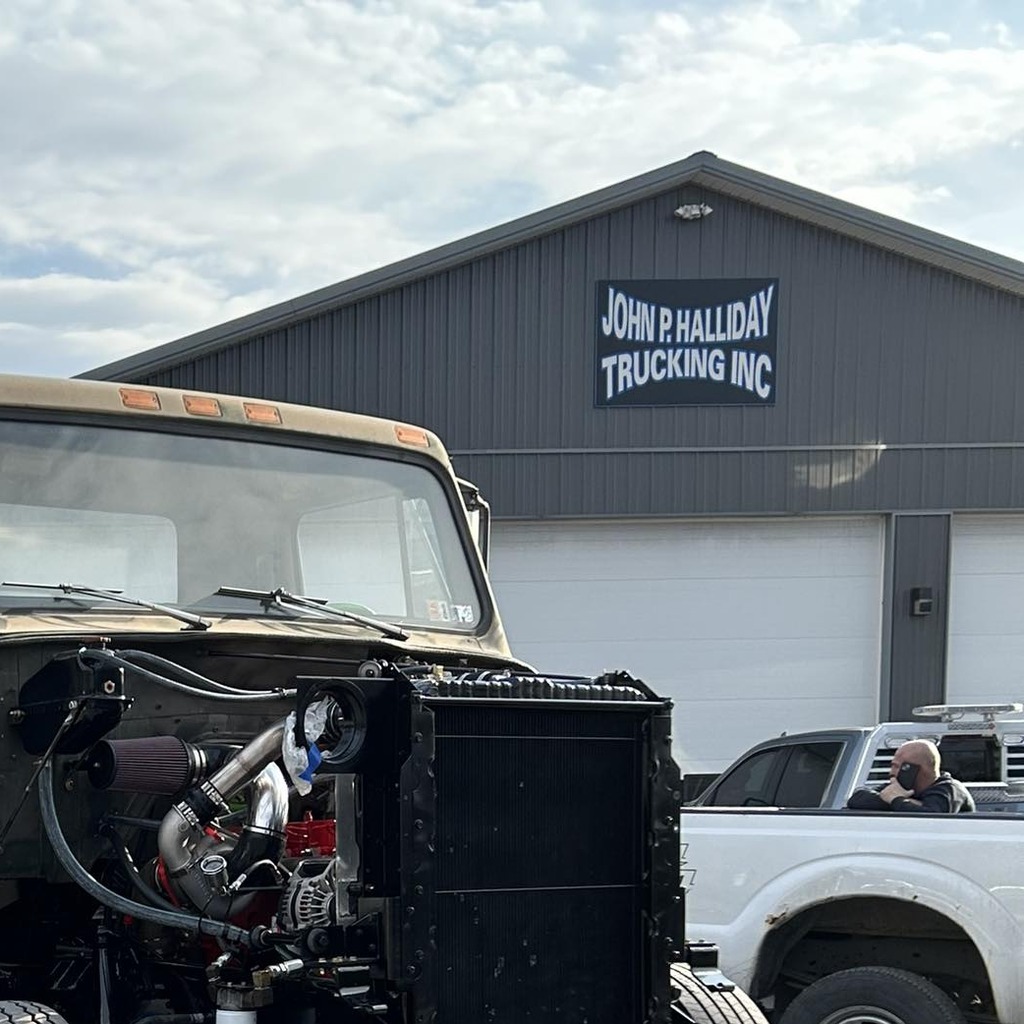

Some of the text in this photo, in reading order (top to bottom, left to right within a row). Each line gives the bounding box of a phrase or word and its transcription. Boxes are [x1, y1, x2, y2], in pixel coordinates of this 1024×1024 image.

[602, 284, 774, 342] JOHN P. HALLIDAY
[602, 348, 772, 399] TRUCKING INC
